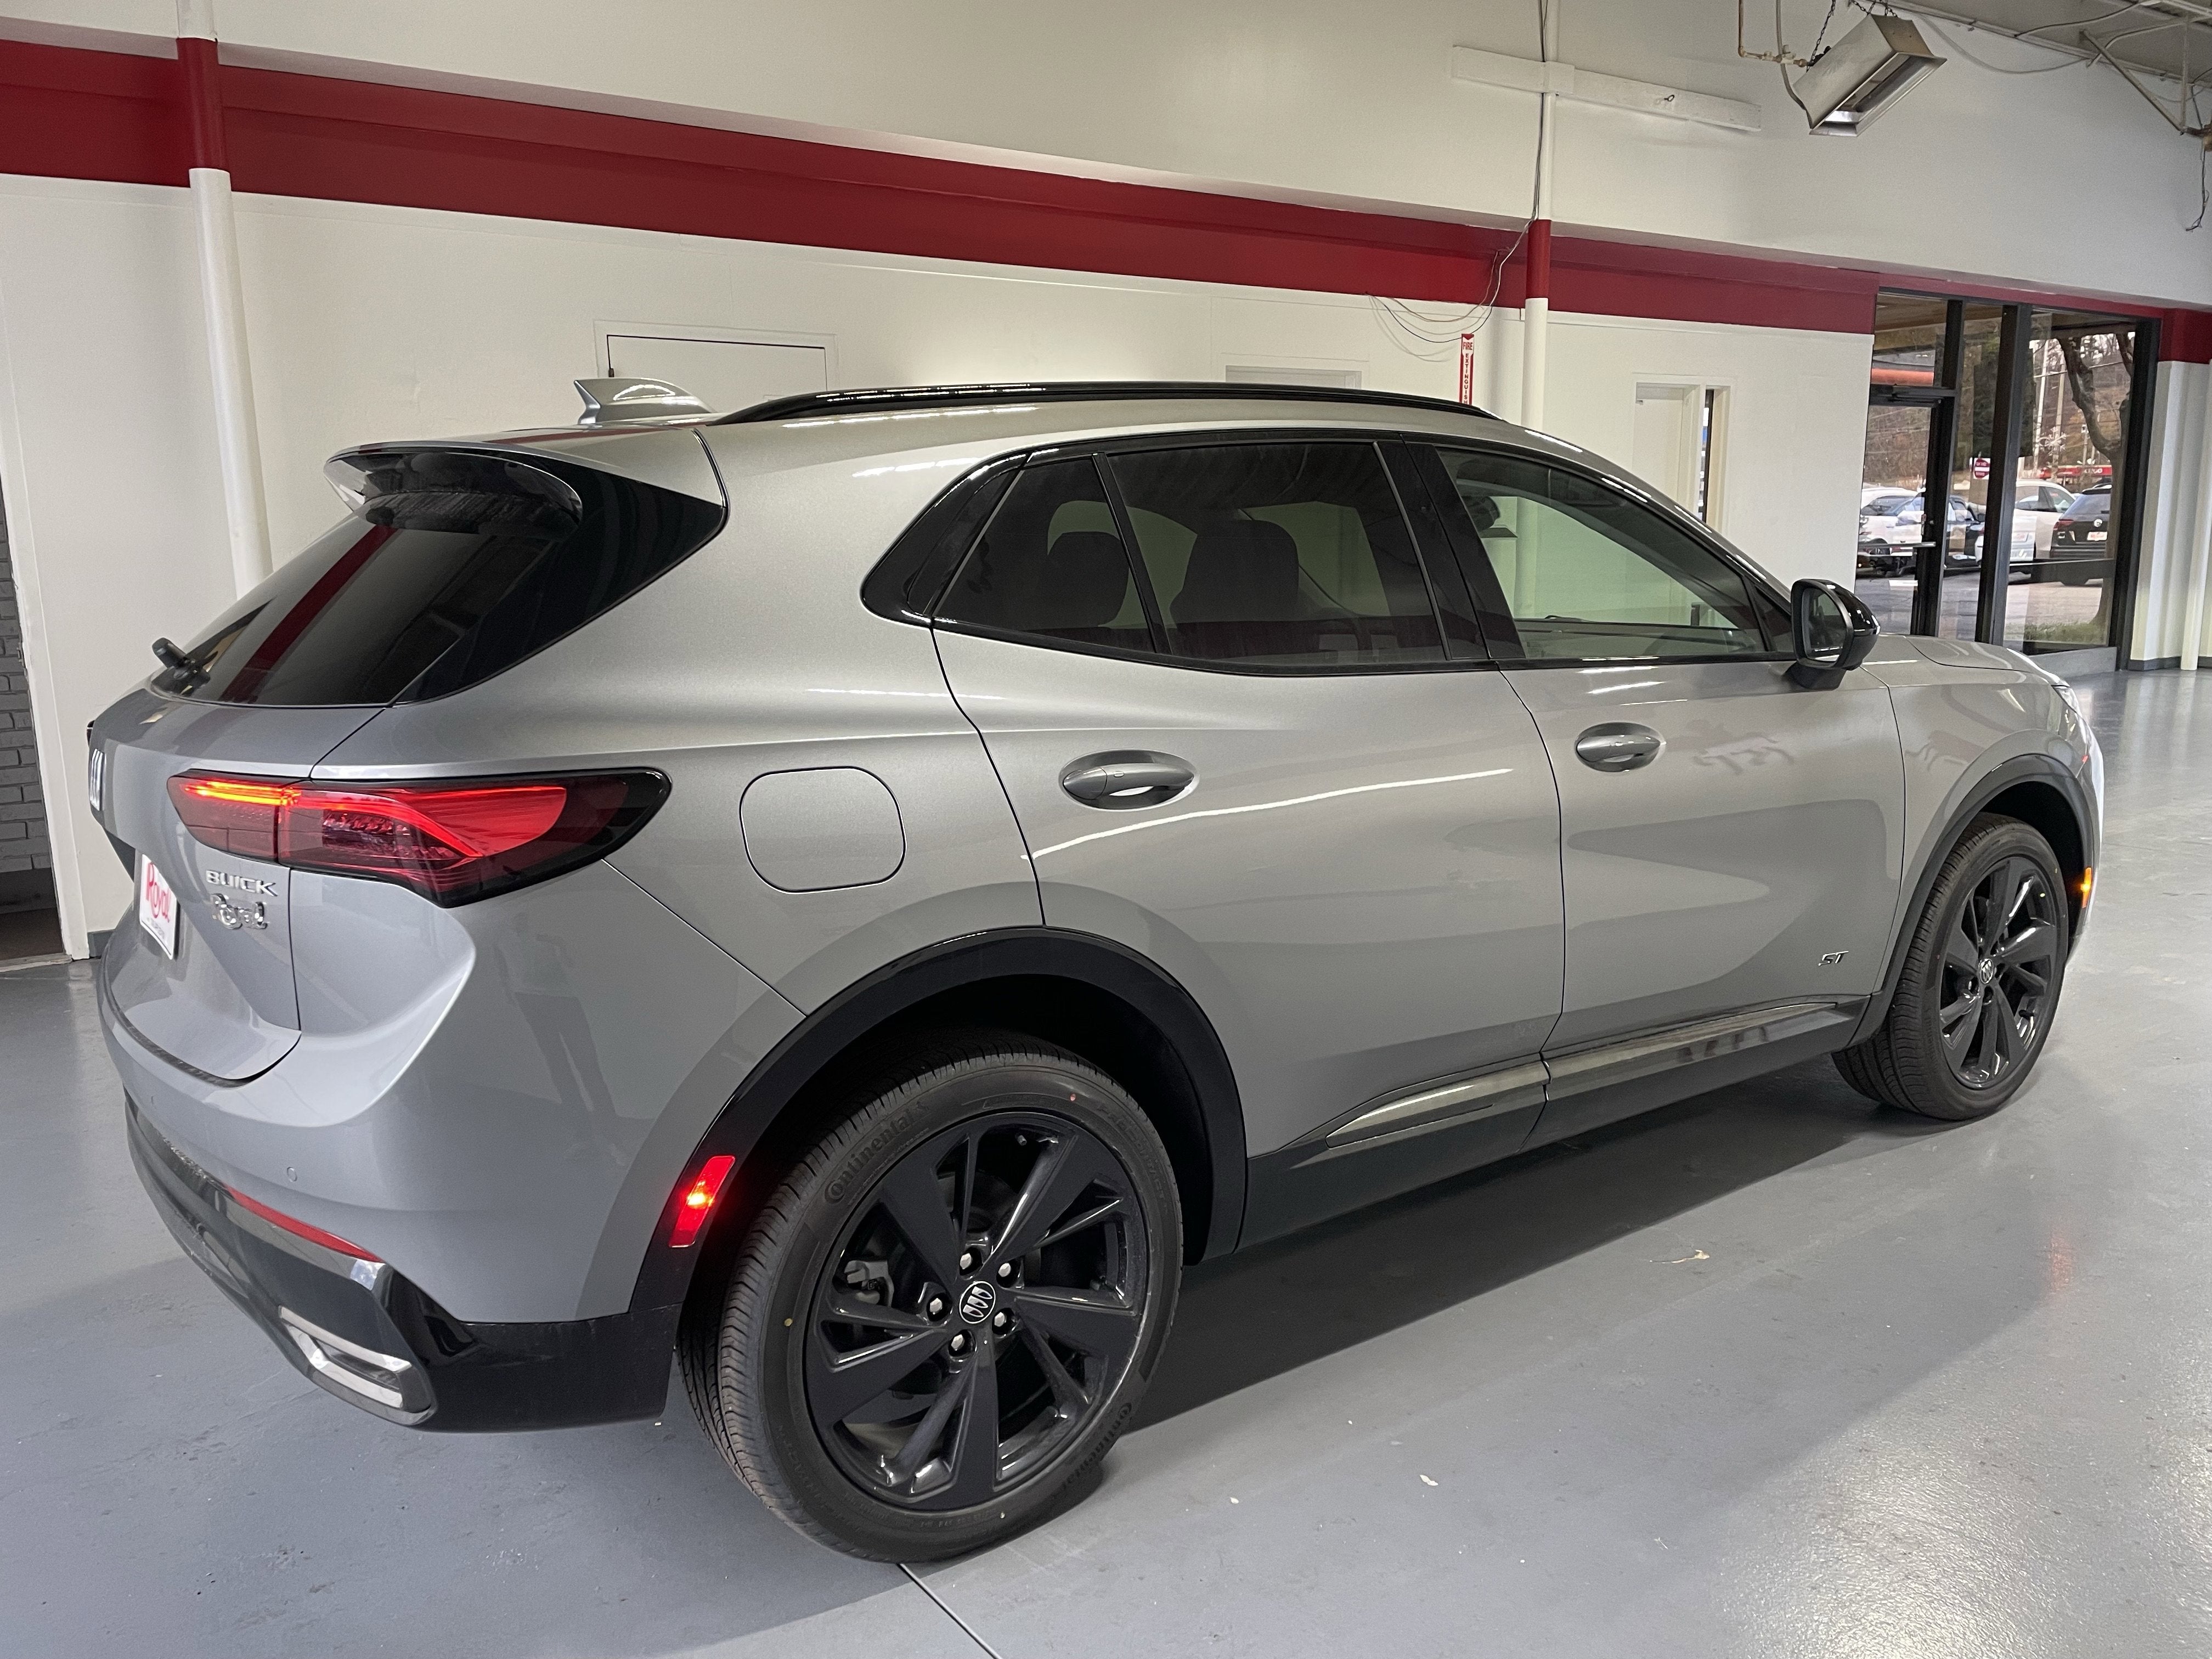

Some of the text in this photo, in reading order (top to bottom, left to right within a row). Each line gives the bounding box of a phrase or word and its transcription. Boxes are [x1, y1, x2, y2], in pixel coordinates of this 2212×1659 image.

[1463, 342, 1473, 351] FIRE
[146, 861, 171, 923] Royal
[206, 870, 278, 896] BUICK
[1818, 950, 1849, 966] ST
[825, 1108, 913, 1204] Continental
